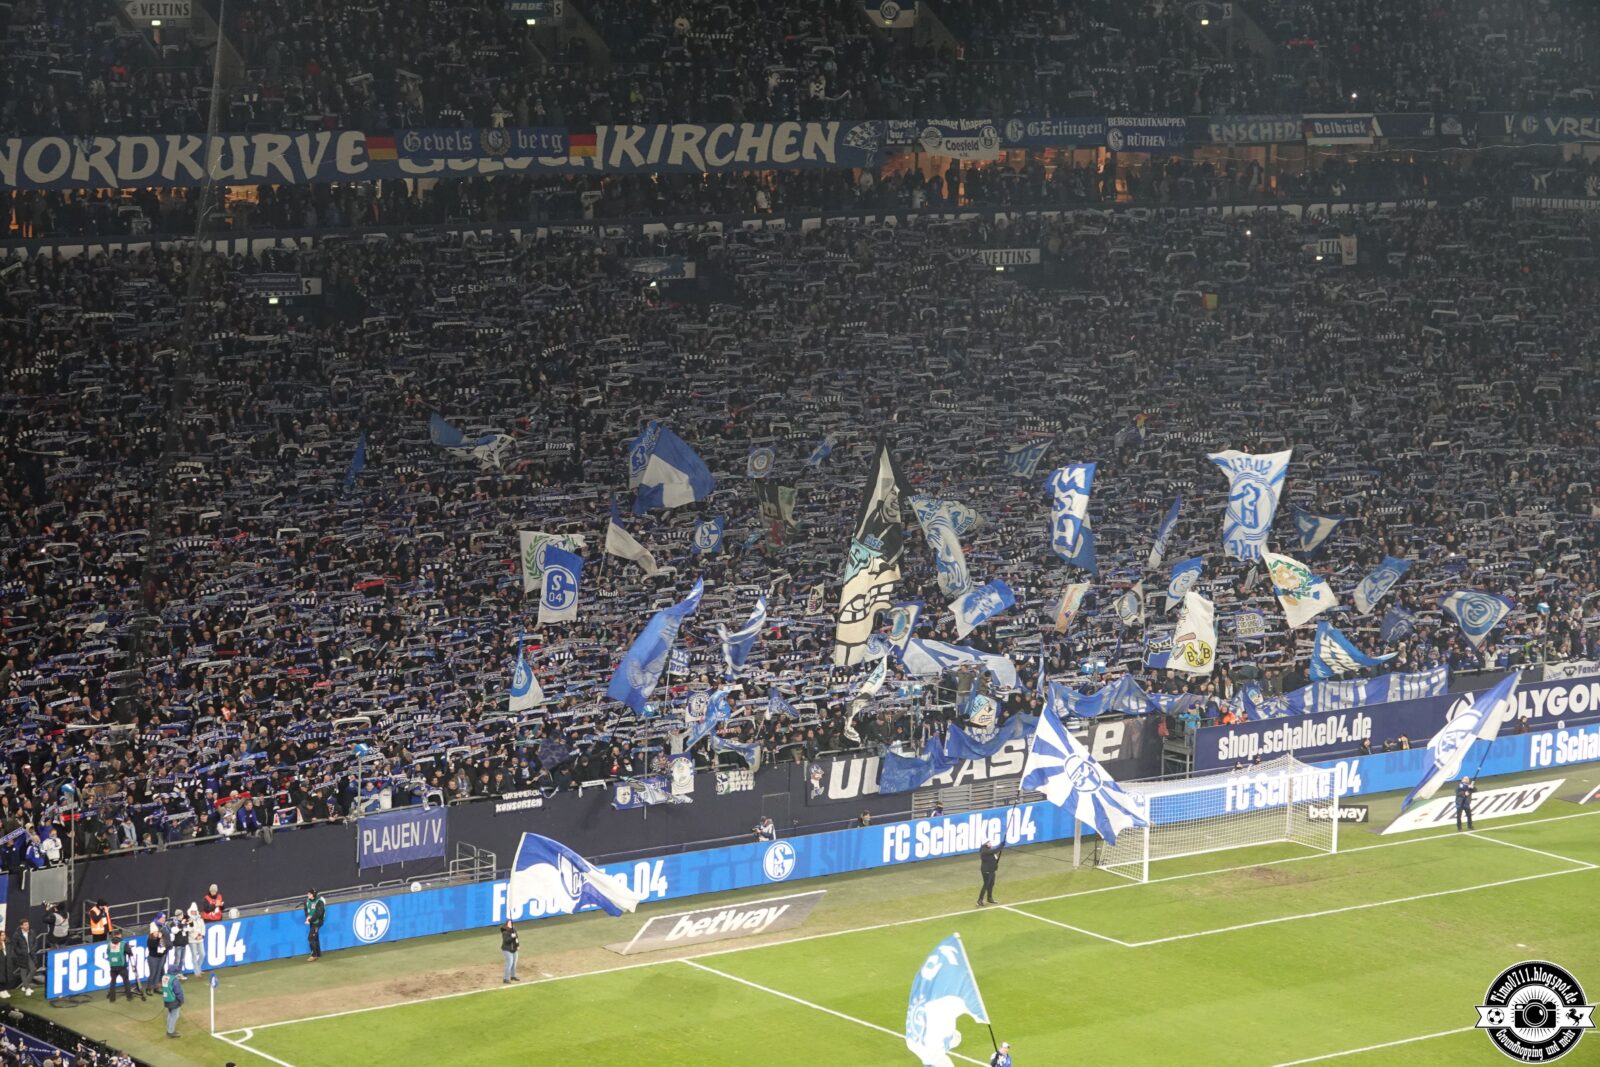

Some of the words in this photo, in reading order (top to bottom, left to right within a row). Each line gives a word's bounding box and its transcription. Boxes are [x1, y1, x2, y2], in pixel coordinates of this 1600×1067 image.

[141, 3, 189, 16] VELTINS
[1107, 117, 1186, 127] BERGSTADTKNAPPEN
[1127, 133, 1166, 147] RÜTHEN
[403, 130, 473, 152] Gevels
[517, 129, 564, 154] berg
[945, 139, 979, 151] Coesfeld
[984, 250, 1031, 265] VELTINS
[1218, 712, 1372, 761] shop.schalke04.de
[1530, 732, 1553, 768] FC
[1555, 728, 1600, 764] Scha
[729, 770, 754, 781] BLUE
[729, 781, 754, 791] BOYZ
[1225, 776, 1250, 812] FC
[1254, 765, 1330, 808] Schalke
[1334, 759, 1361, 797] 04
[1433, 786, 1549, 822] VLTINS
[363, 821, 420, 855] PLAUEN
[432, 818, 443, 844] V.
[883, 823, 911, 863] FC
[915, 812, 1001, 858] Schalke
[1006, 805, 1036, 844] 04
[633, 860, 668, 900] 04
[665, 904, 791, 942] betway
[53, 948, 88, 994] FC
[207, 921, 246, 967] 04
